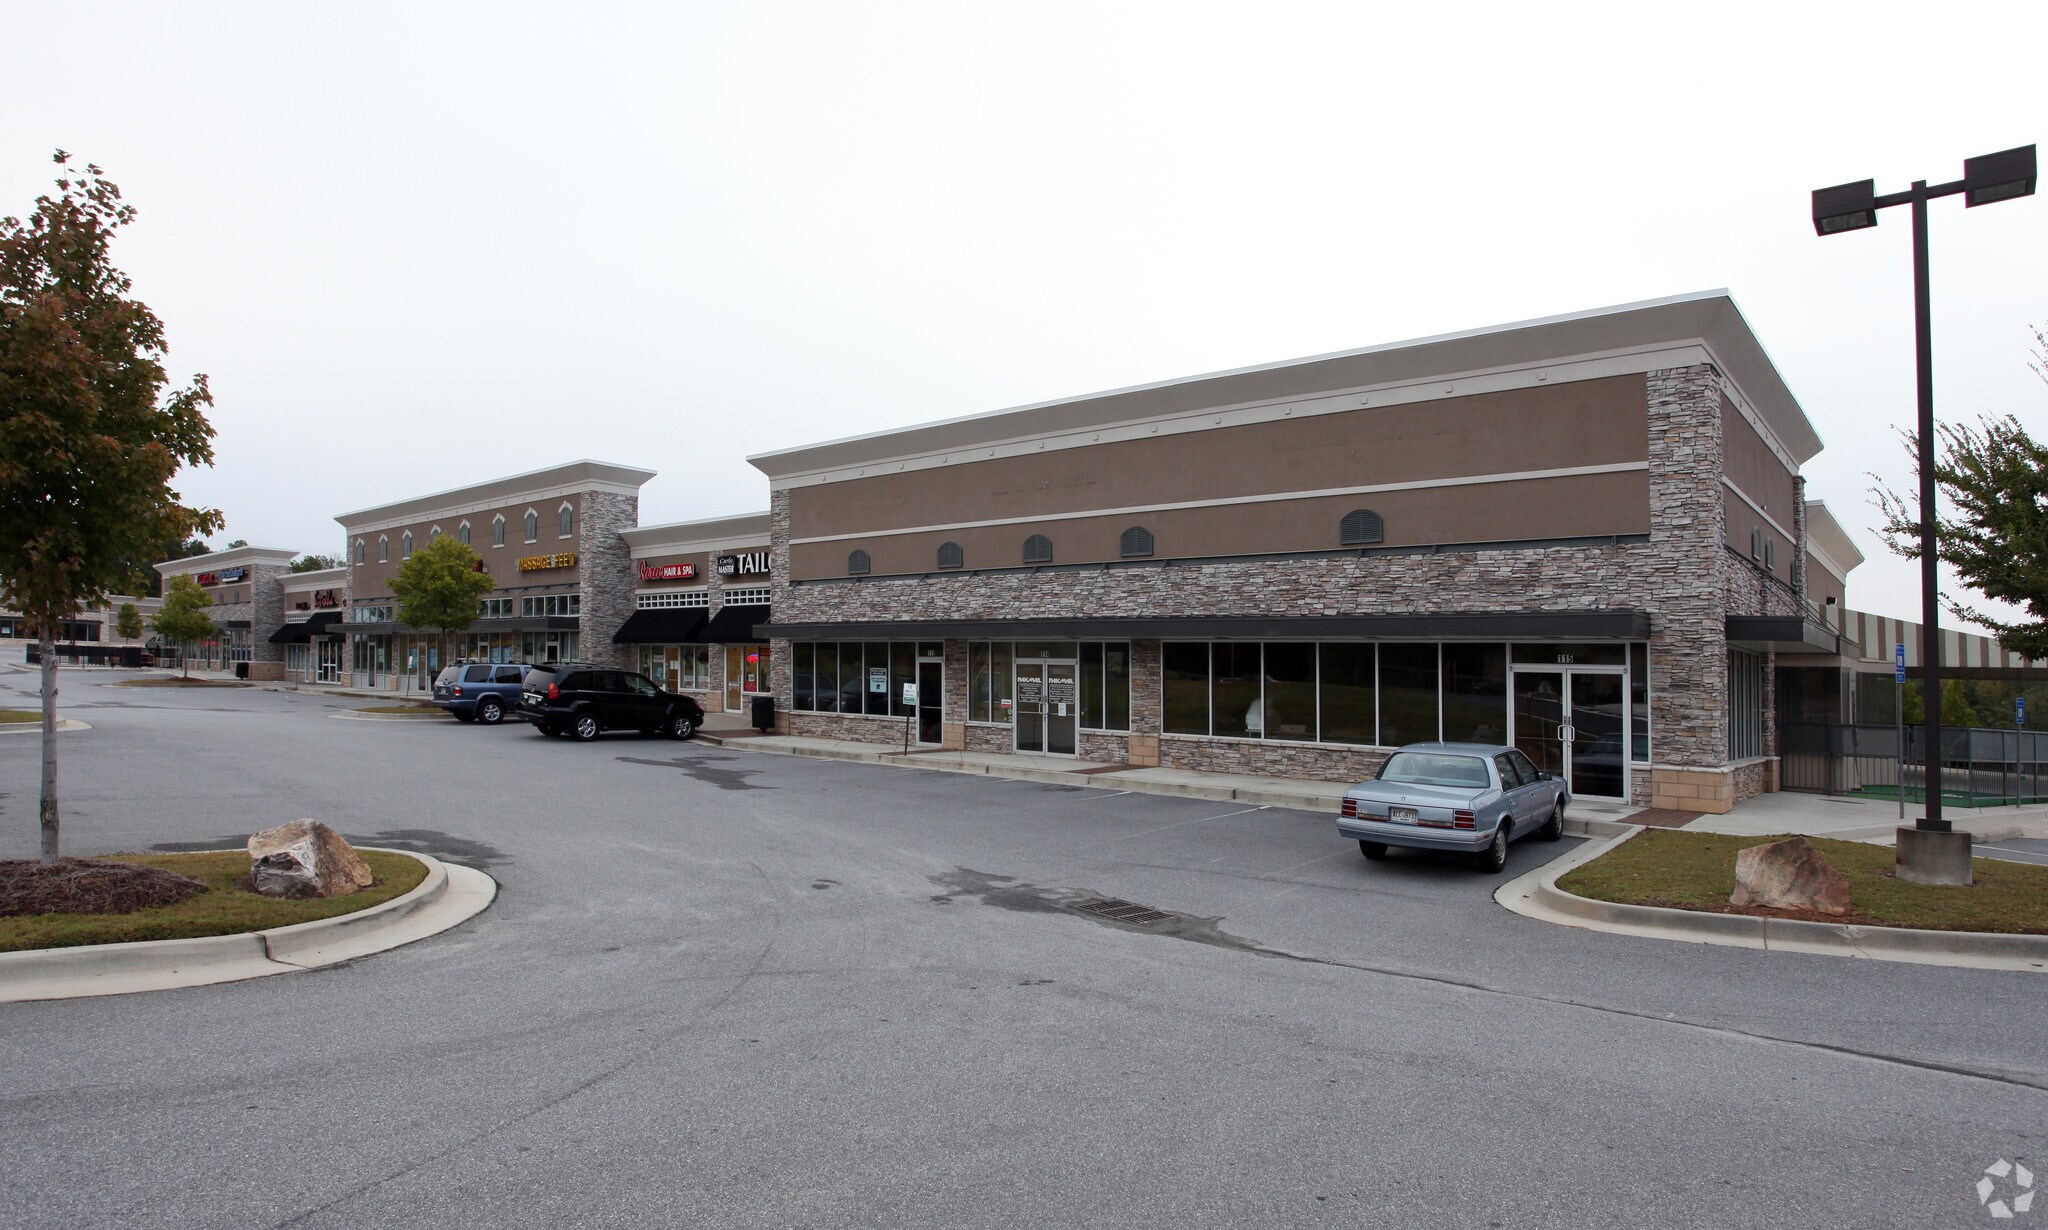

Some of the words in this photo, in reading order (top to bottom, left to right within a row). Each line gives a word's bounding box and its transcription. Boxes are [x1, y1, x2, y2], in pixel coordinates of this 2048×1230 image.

[518, 554, 551, 571] MASSAGE
[663, 567, 677, 577] HAIR
[677, 566, 682, 576] &
[682, 564, 693, 575] SPA
[718, 565, 735, 573] MASTER
[1557, 654, 1574, 664] 115
